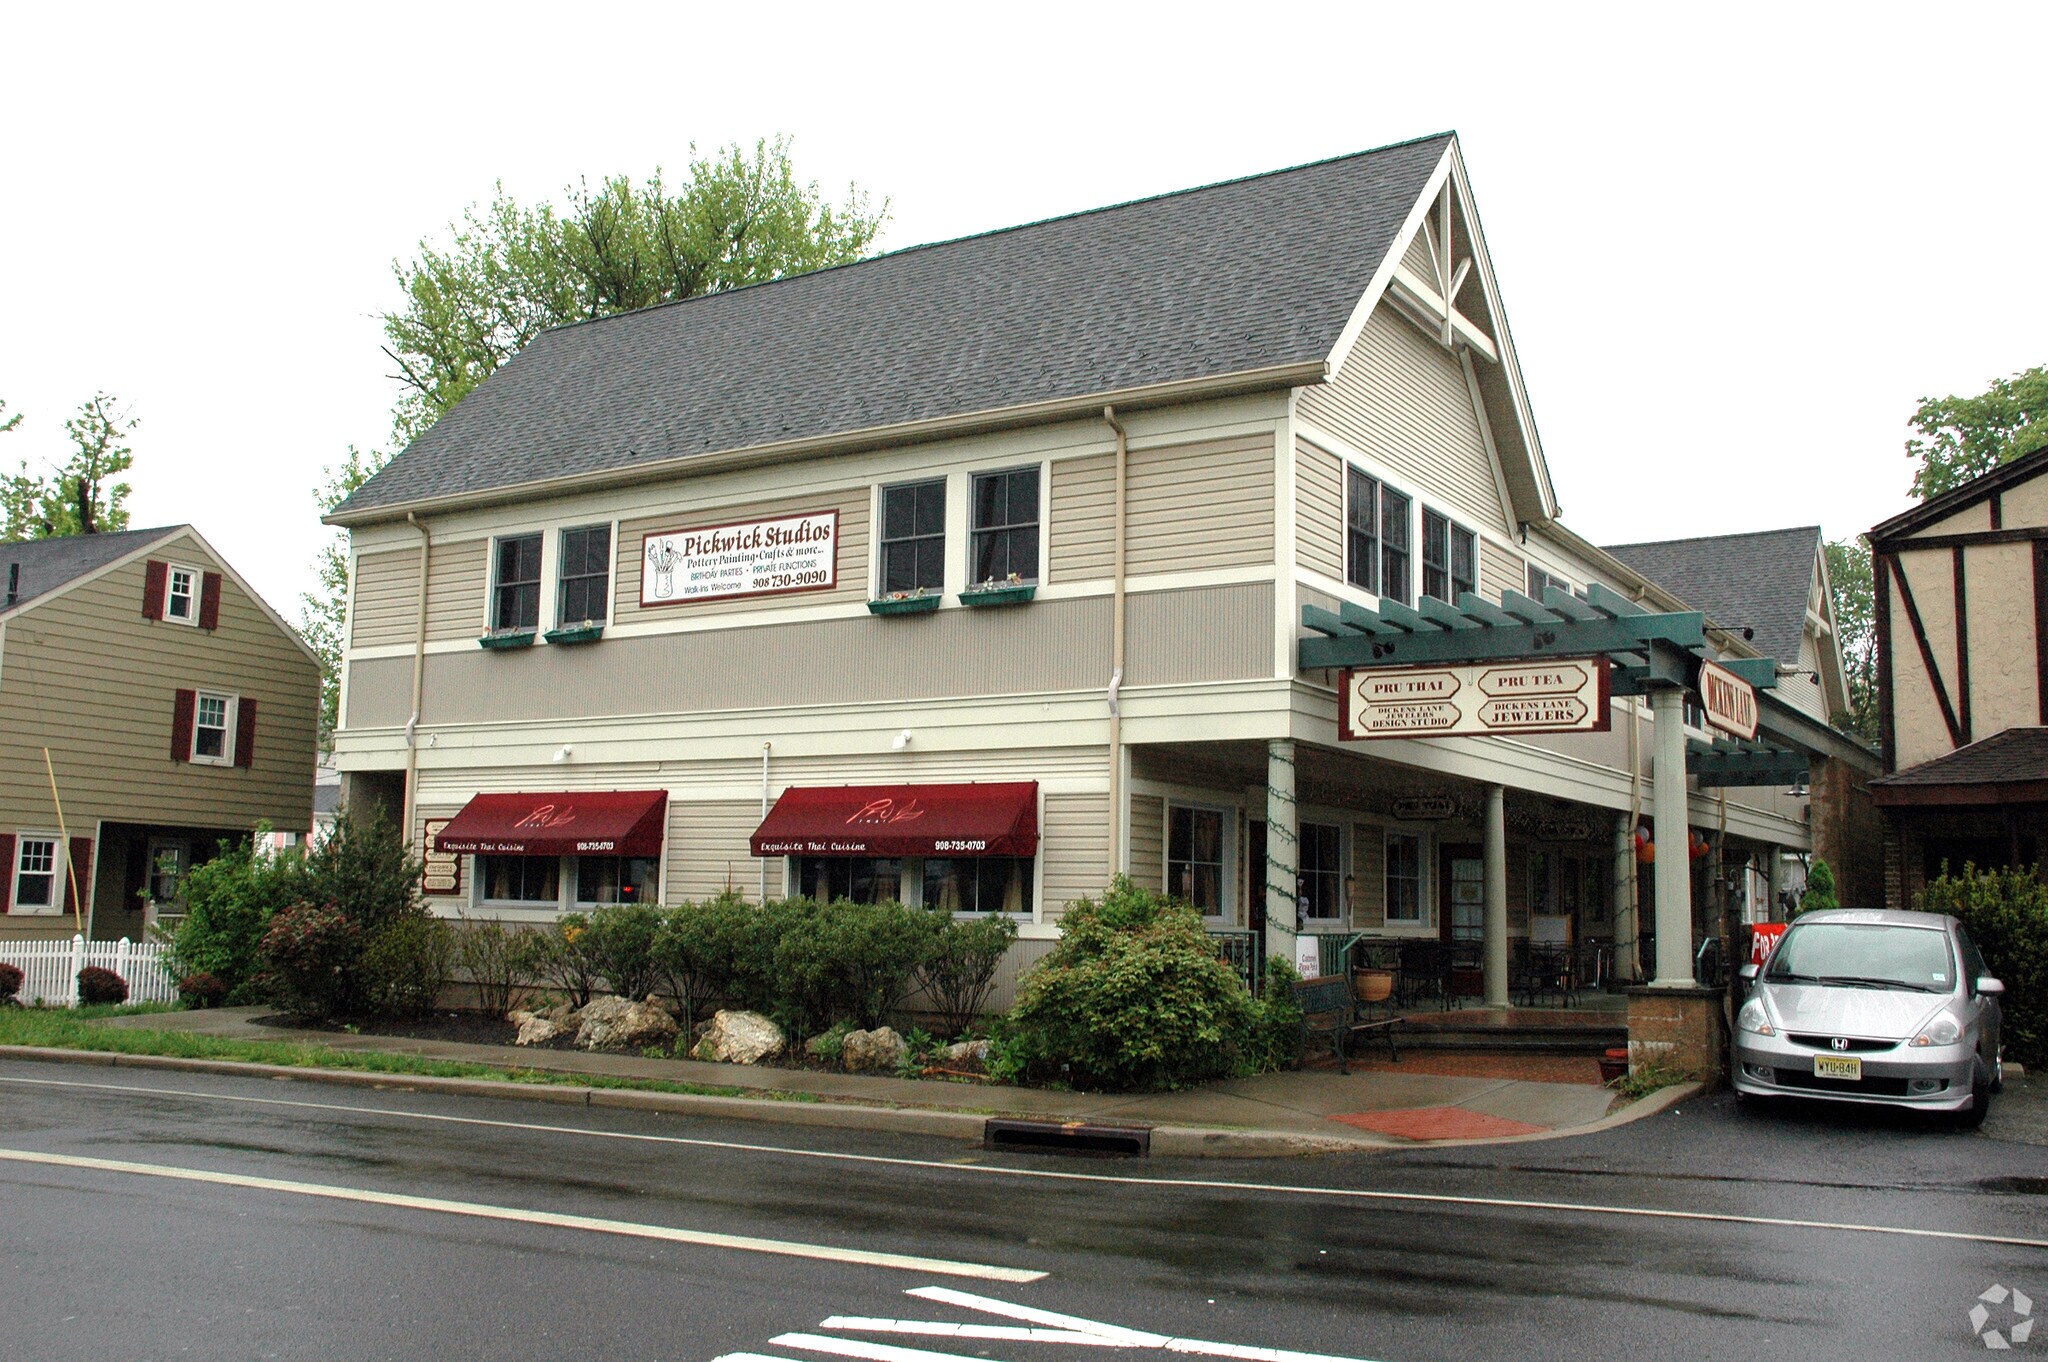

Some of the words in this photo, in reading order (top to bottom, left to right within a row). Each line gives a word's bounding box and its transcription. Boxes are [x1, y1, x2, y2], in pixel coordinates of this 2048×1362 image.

[683, 526, 762, 556] Pickwick
[765, 520, 830, 547] Studios
[687, 558, 717, 570] Pottery
[786, 546, 794, 557] &
[691, 570, 718, 581] BIRTHDAY
[720, 567, 743, 578] PARTIES
[752, 562, 776, 574] PRIVATE
[779, 559, 817, 571] FUNCTIONS
[752, 578, 770, 589] 908
[771, 570, 827, 588] 730-9090
[711, 582, 741, 591] Welcome
[1498, 676, 1528, 688] PRU
[1532, 674, 1563, 686] TEA
[1374, 683, 1403, 694] PRU
[1406, 681, 1443, 692] THAI
[1495, 701, 1539, 711] DICKENS
[1543, 700, 1571, 709] LANE
[1706, 671, 1735, 721] DICKENS
[1735, 686, 1751, 729] LANE
[1378, 705, 1416, 714] DICKENS
[1420, 704, 1445, 712] LANE
[1386, 711, 1434, 719] JEWELERS
[1492, 709, 1574, 722] JEWELERS
[1372, 719, 1407, 728] DESIGN
[1411, 718, 1448, 727] STUDIO
[443, 841, 478, 851] Exquisite
[480, 842, 496, 851] Thai
[498, 842, 525, 852] Cuisine
[761, 842, 804, 852] Exquisite
[808, 842, 826, 851] Thai
[831, 842, 866, 851] Cuisine
[935, 840, 986, 851] 908-735-0703
